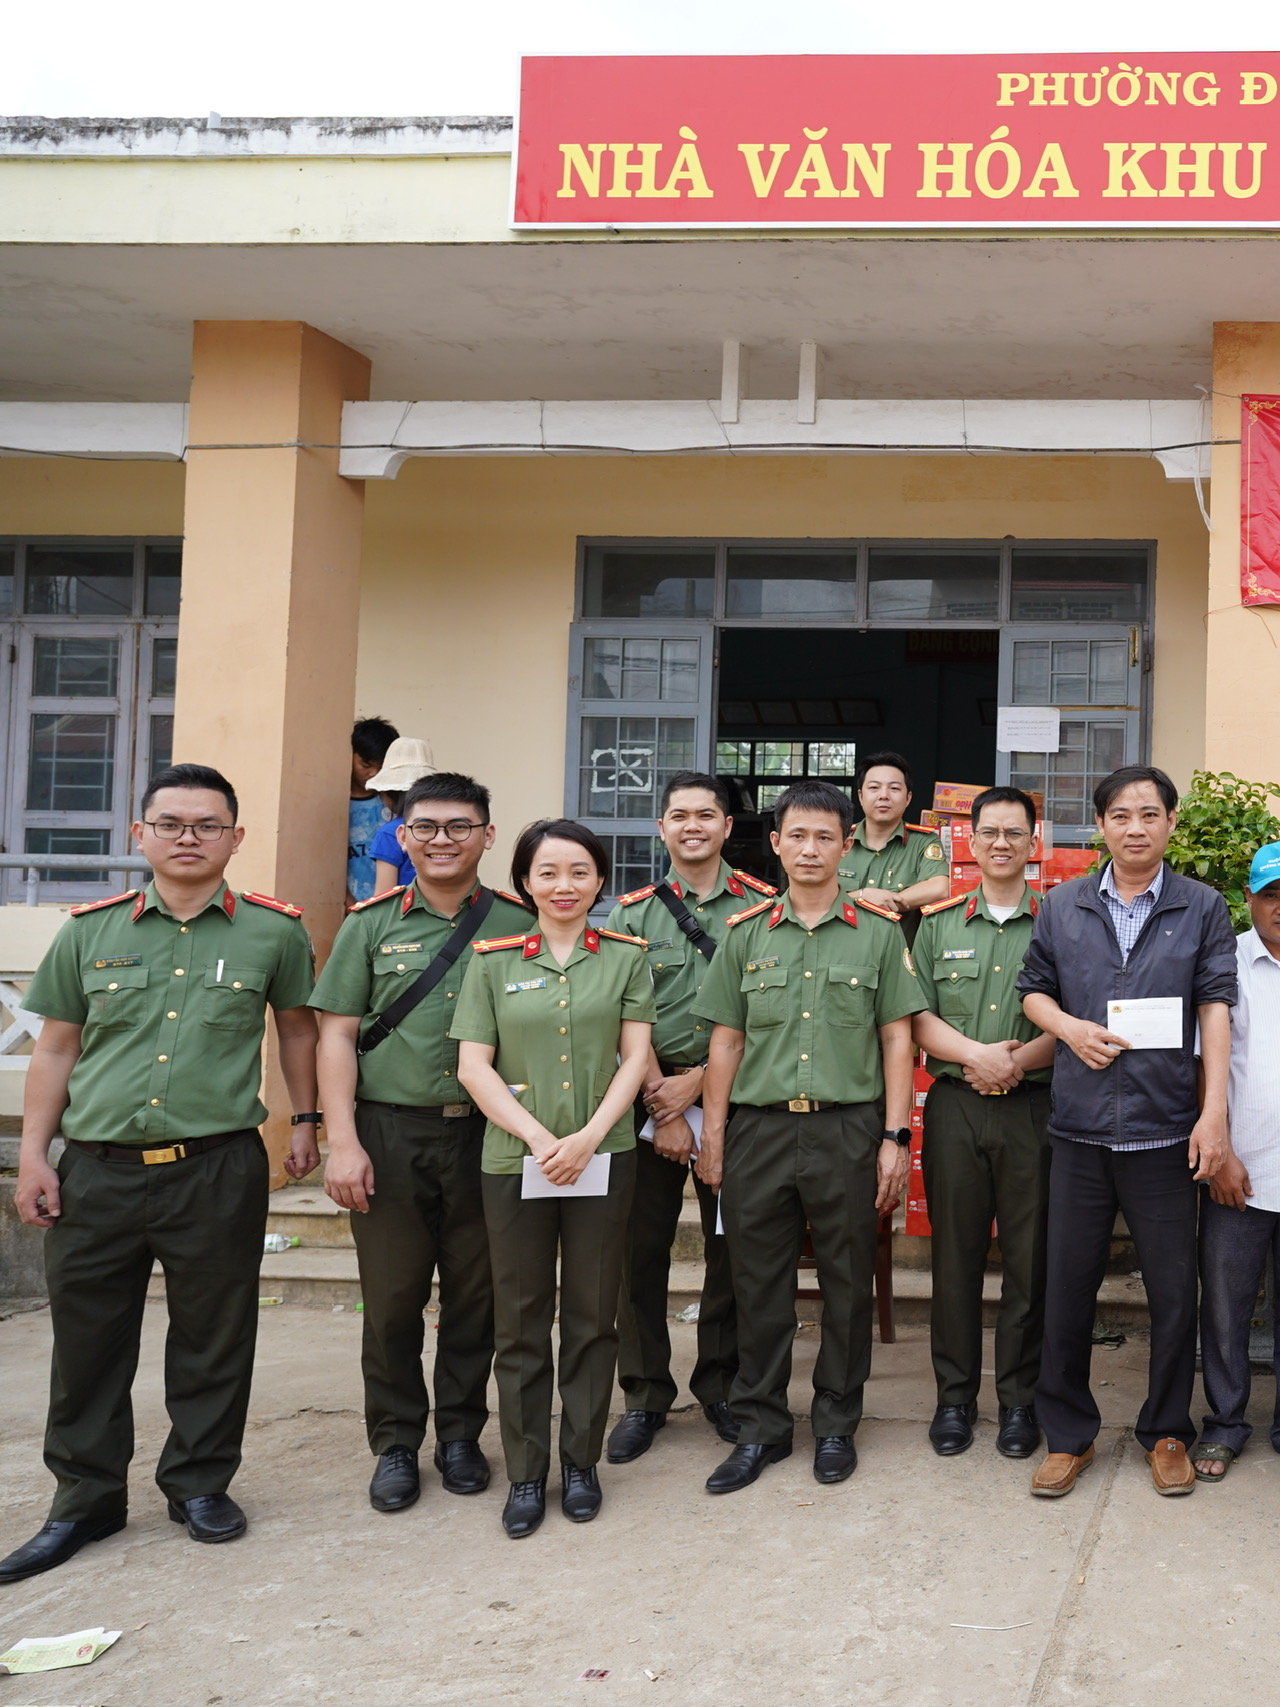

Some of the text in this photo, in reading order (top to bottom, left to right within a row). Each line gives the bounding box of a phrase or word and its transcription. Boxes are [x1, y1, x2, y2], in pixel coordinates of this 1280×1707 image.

[996, 62, 1221, 106] PHƯỜNG
[557, 126, 714, 198] NHÀ
[738, 127, 891, 197] VĂN
[916, 125, 1079, 199] HÓA
[1102, 143, 1267, 198] KHU
